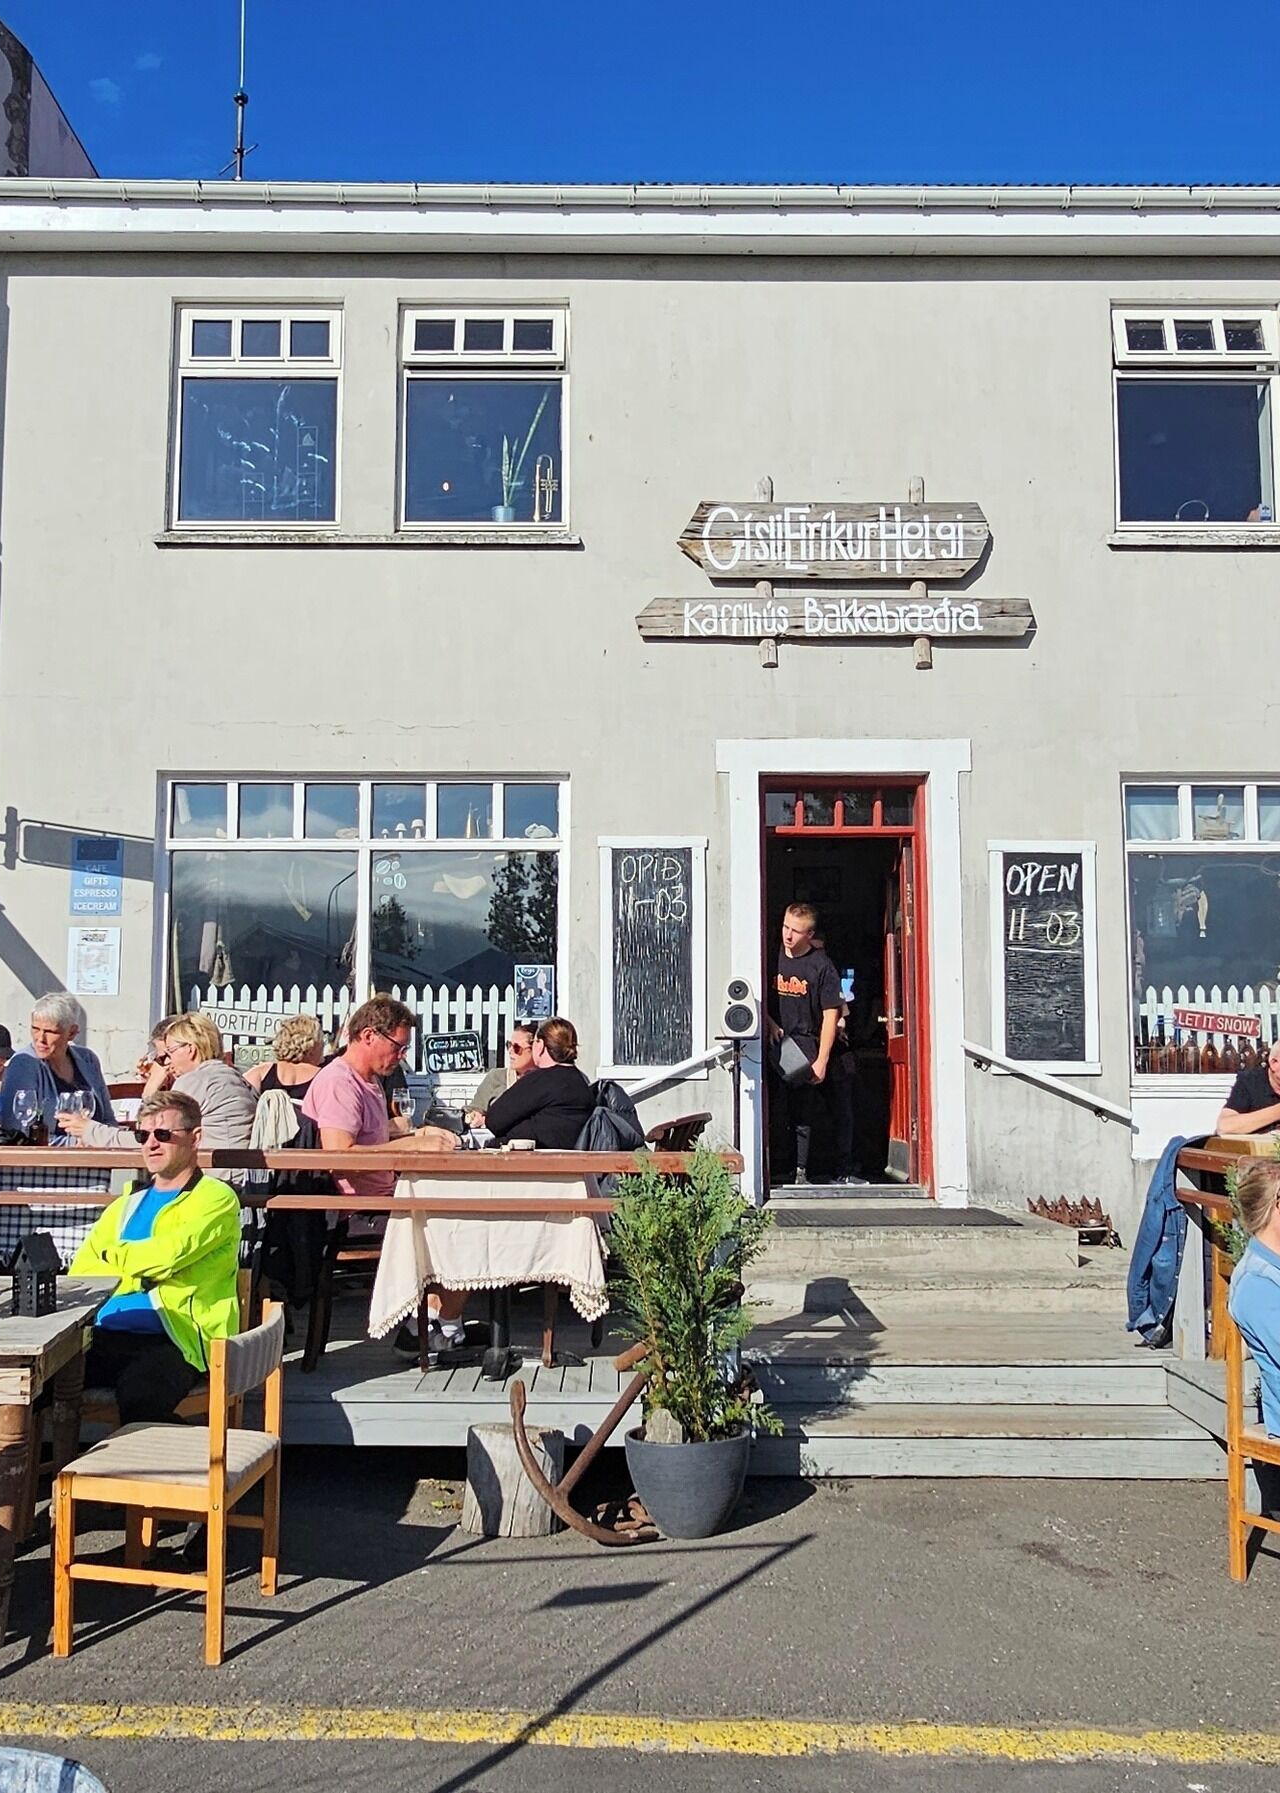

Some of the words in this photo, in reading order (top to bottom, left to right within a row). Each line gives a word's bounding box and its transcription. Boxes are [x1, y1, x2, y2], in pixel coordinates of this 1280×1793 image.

[1006, 861, 1079, 896] OPEN
[73, 888, 118, 898] ESPRESSO
[206, 1011, 258, 1032] NORTH
[1178, 1012, 1201, 1027] LET
[1202, 1014, 1215, 1029] IT
[1216, 1016, 1255, 1034] SNOW
[428, 1049, 479, 1072] OPEN
